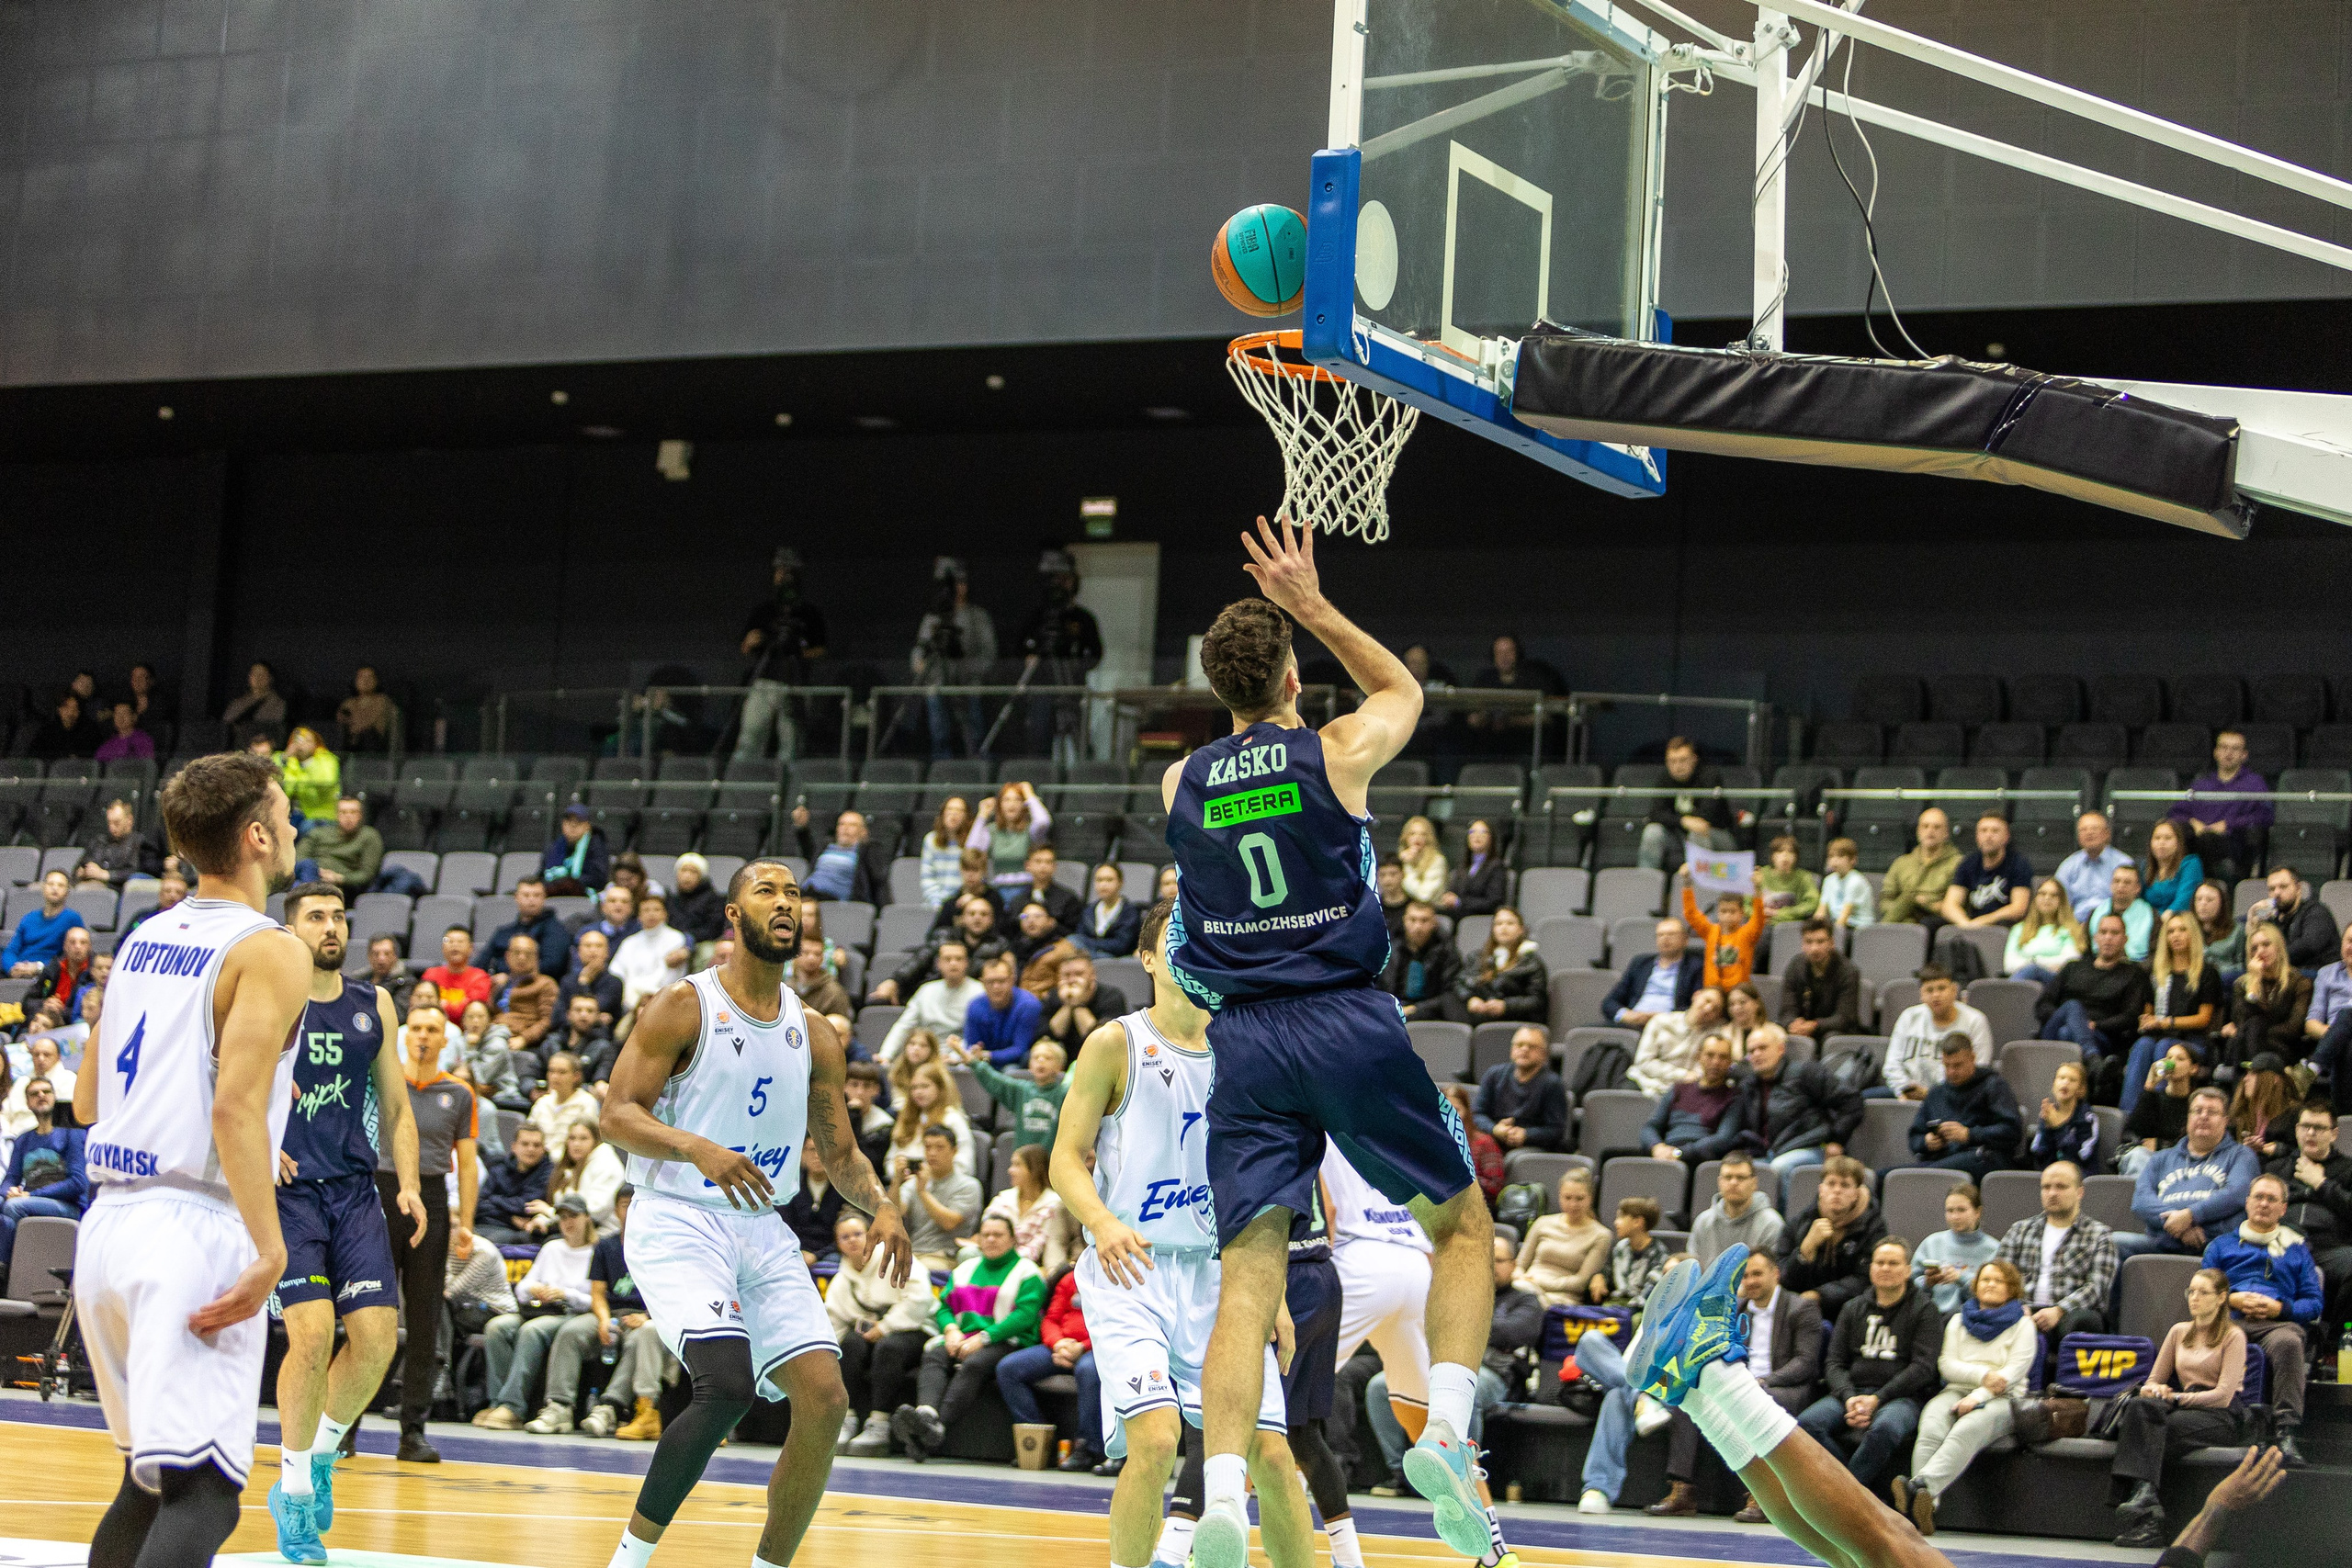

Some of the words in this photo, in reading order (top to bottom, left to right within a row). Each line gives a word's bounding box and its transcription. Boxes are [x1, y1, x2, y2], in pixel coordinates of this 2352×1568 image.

[1206, 743, 1287, 787] KASKO
[1238, 832, 1288, 908] 0
[1204, 906, 1349, 935] BELTAMOZHSERVICE
[123, 941, 216, 977] TOPTUNOV
[117, 1010, 146, 1100] 4
[308, 1032, 343, 1066] 55
[748, 1077, 773, 1117] 5
[1181, 1111, 1202, 1151] 7
[278, 1277, 307, 1290] Kempa
[1564, 1317, 1620, 1345] VIP
[1860, 1314, 1897, 1359] LA
[2075, 1348, 2137, 1379] VIP
